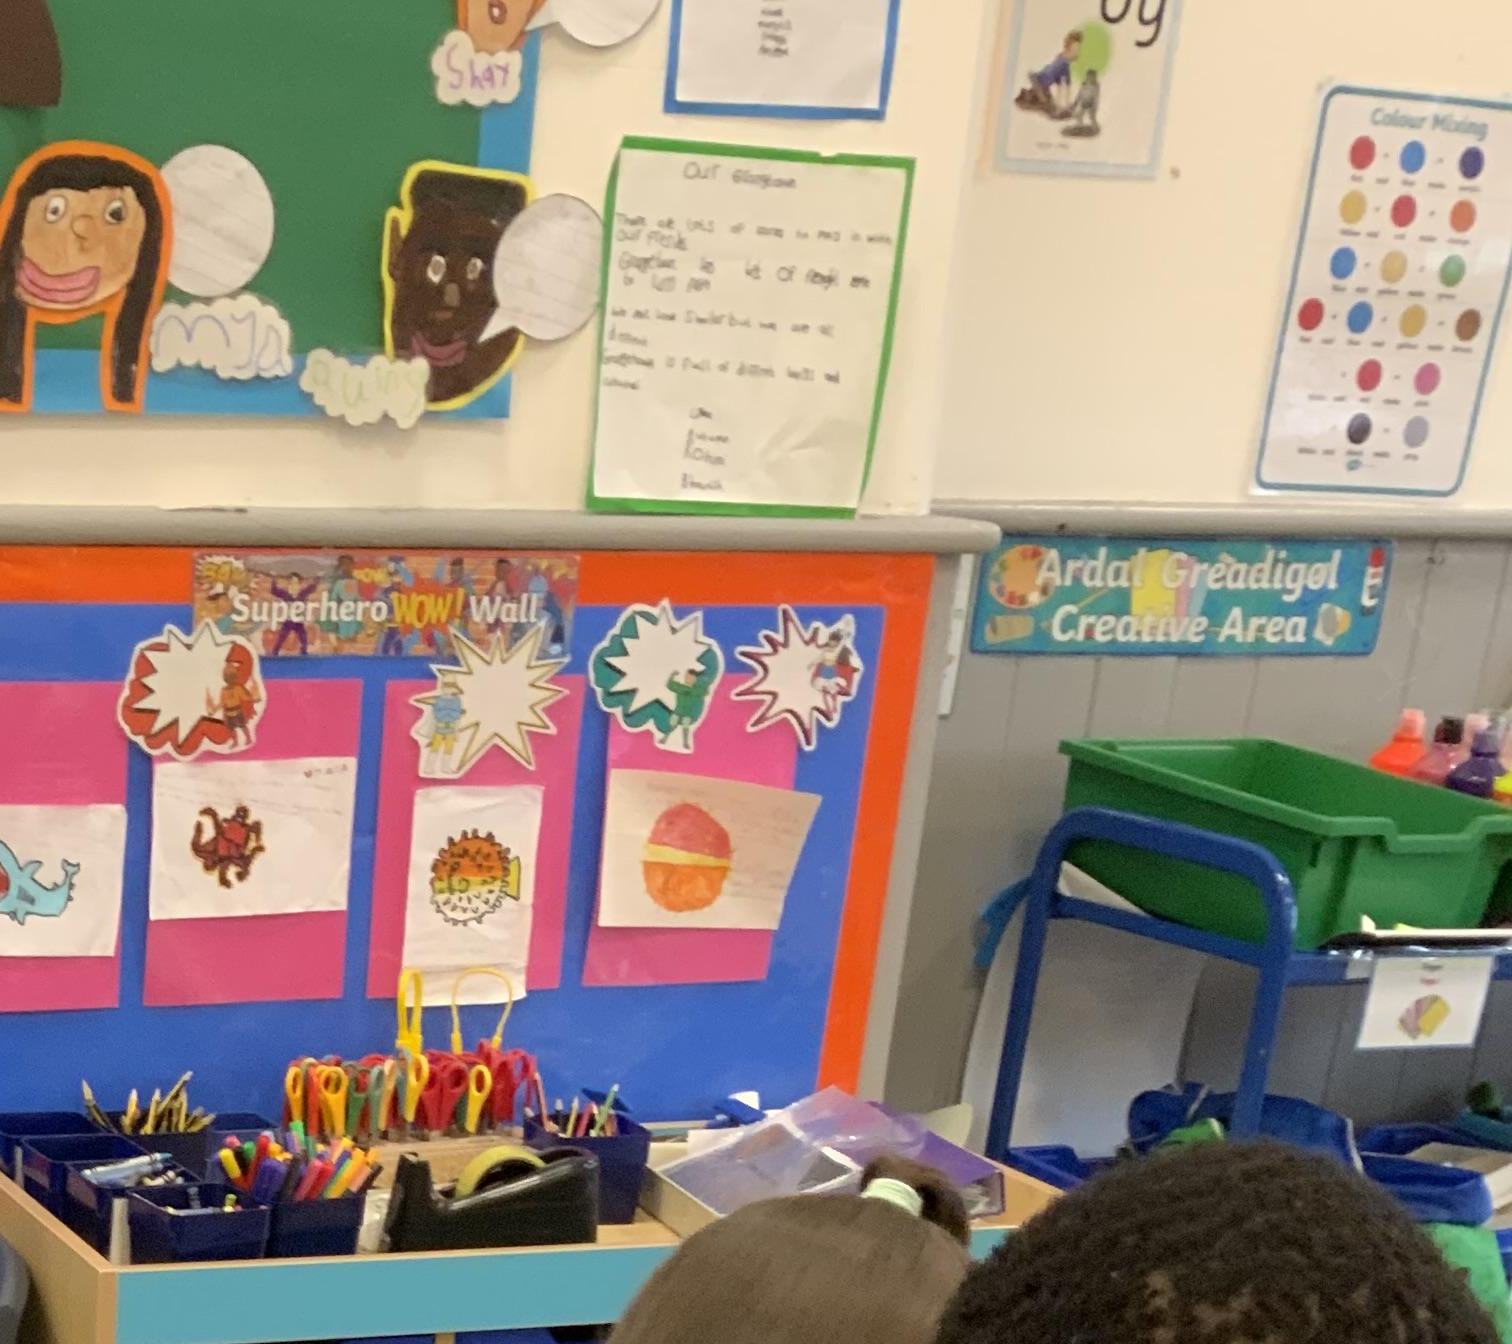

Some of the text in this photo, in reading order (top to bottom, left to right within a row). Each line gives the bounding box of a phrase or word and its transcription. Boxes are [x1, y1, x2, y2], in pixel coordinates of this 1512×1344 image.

[1369, 107, 1489, 142] Colour Mixing
[1035, 546, 1341, 602] Ardal Greadigol
[230, 587, 539, 631] Superhero WOW! Wall
[1050, 604, 1307, 643] Creative Area
